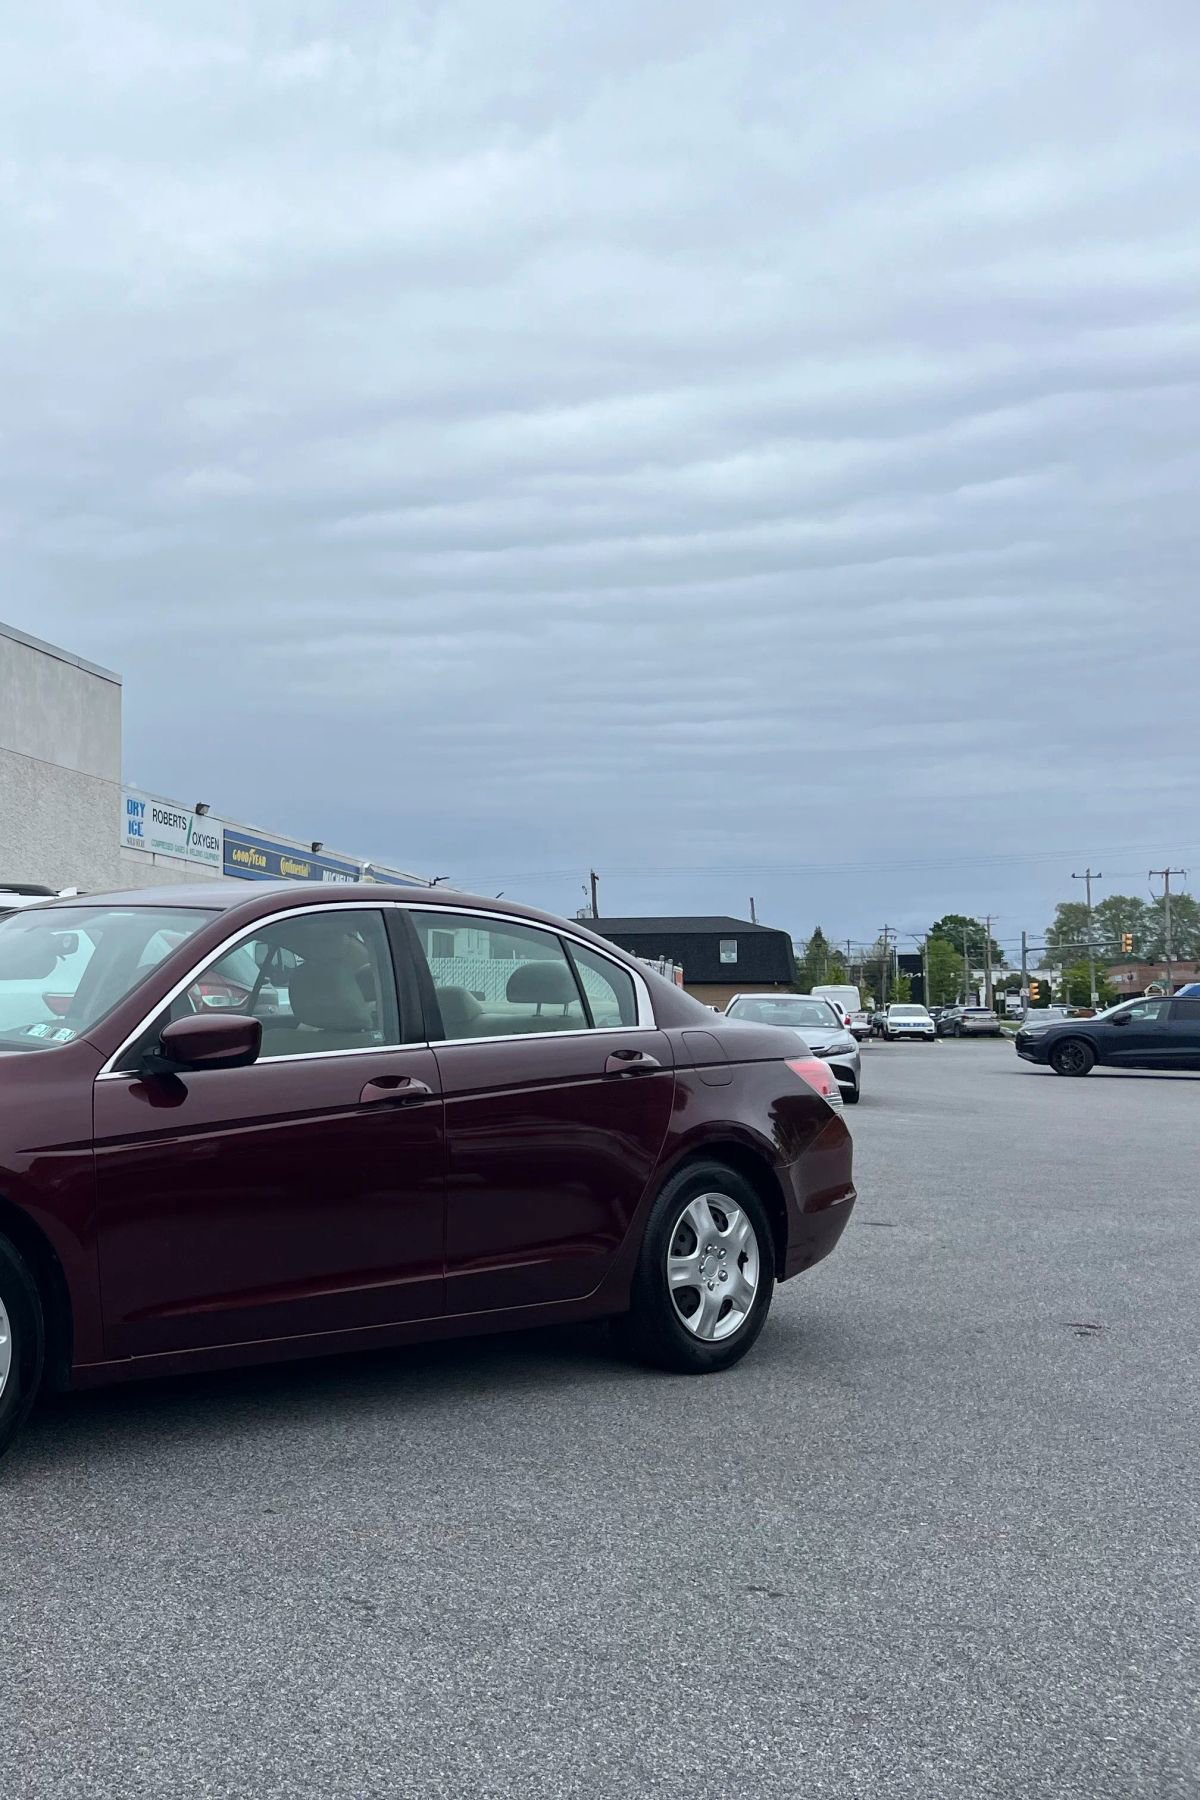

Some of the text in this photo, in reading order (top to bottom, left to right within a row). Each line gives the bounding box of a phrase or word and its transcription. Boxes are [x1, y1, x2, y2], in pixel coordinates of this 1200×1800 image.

[127, 799, 146, 818] DRY
[128, 820, 144, 837] ICE
[152, 808, 187, 830] ROBERTS
[192, 831, 220, 850] OXYGEN
[232, 848, 266, 867] GOODYEAR
[280, 856, 310, 878] Continental
